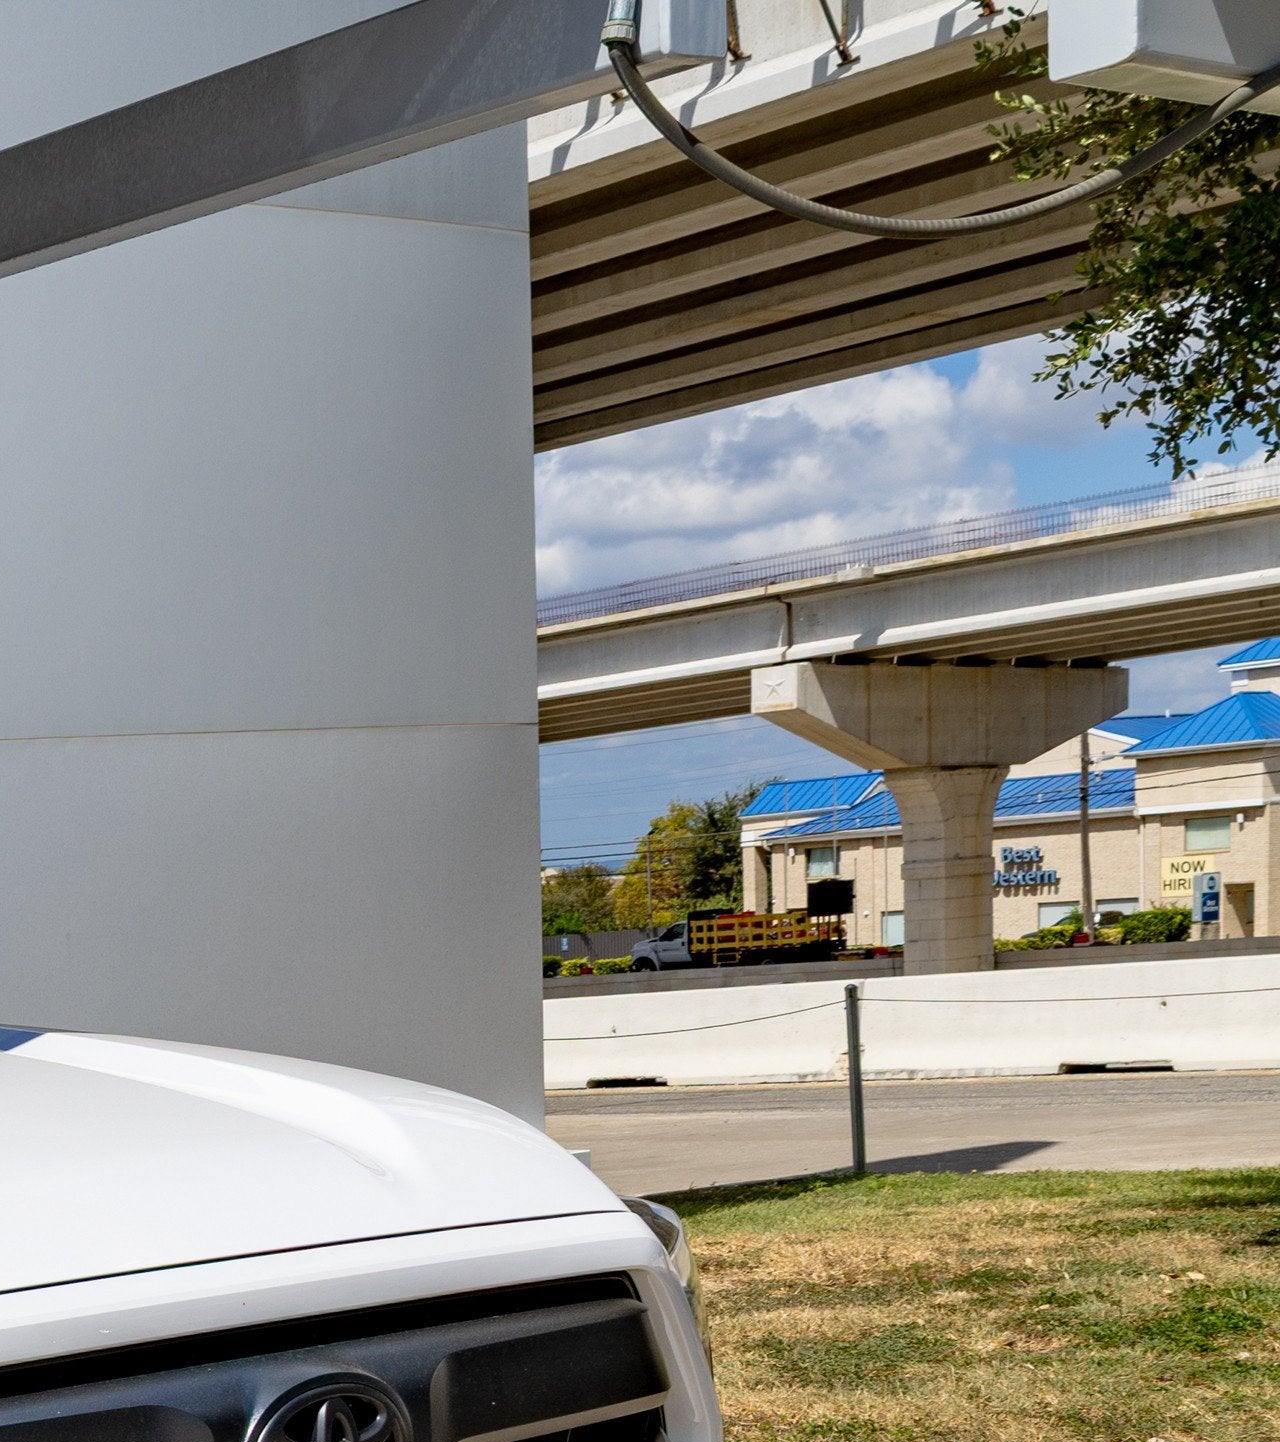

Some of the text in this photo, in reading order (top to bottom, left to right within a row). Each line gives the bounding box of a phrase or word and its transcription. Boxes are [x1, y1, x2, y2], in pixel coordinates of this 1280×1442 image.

[1001, 846, 1041, 864] Best
[1170, 860, 1206, 874] NOW
[1163, 878, 1192, 891] HIRI
